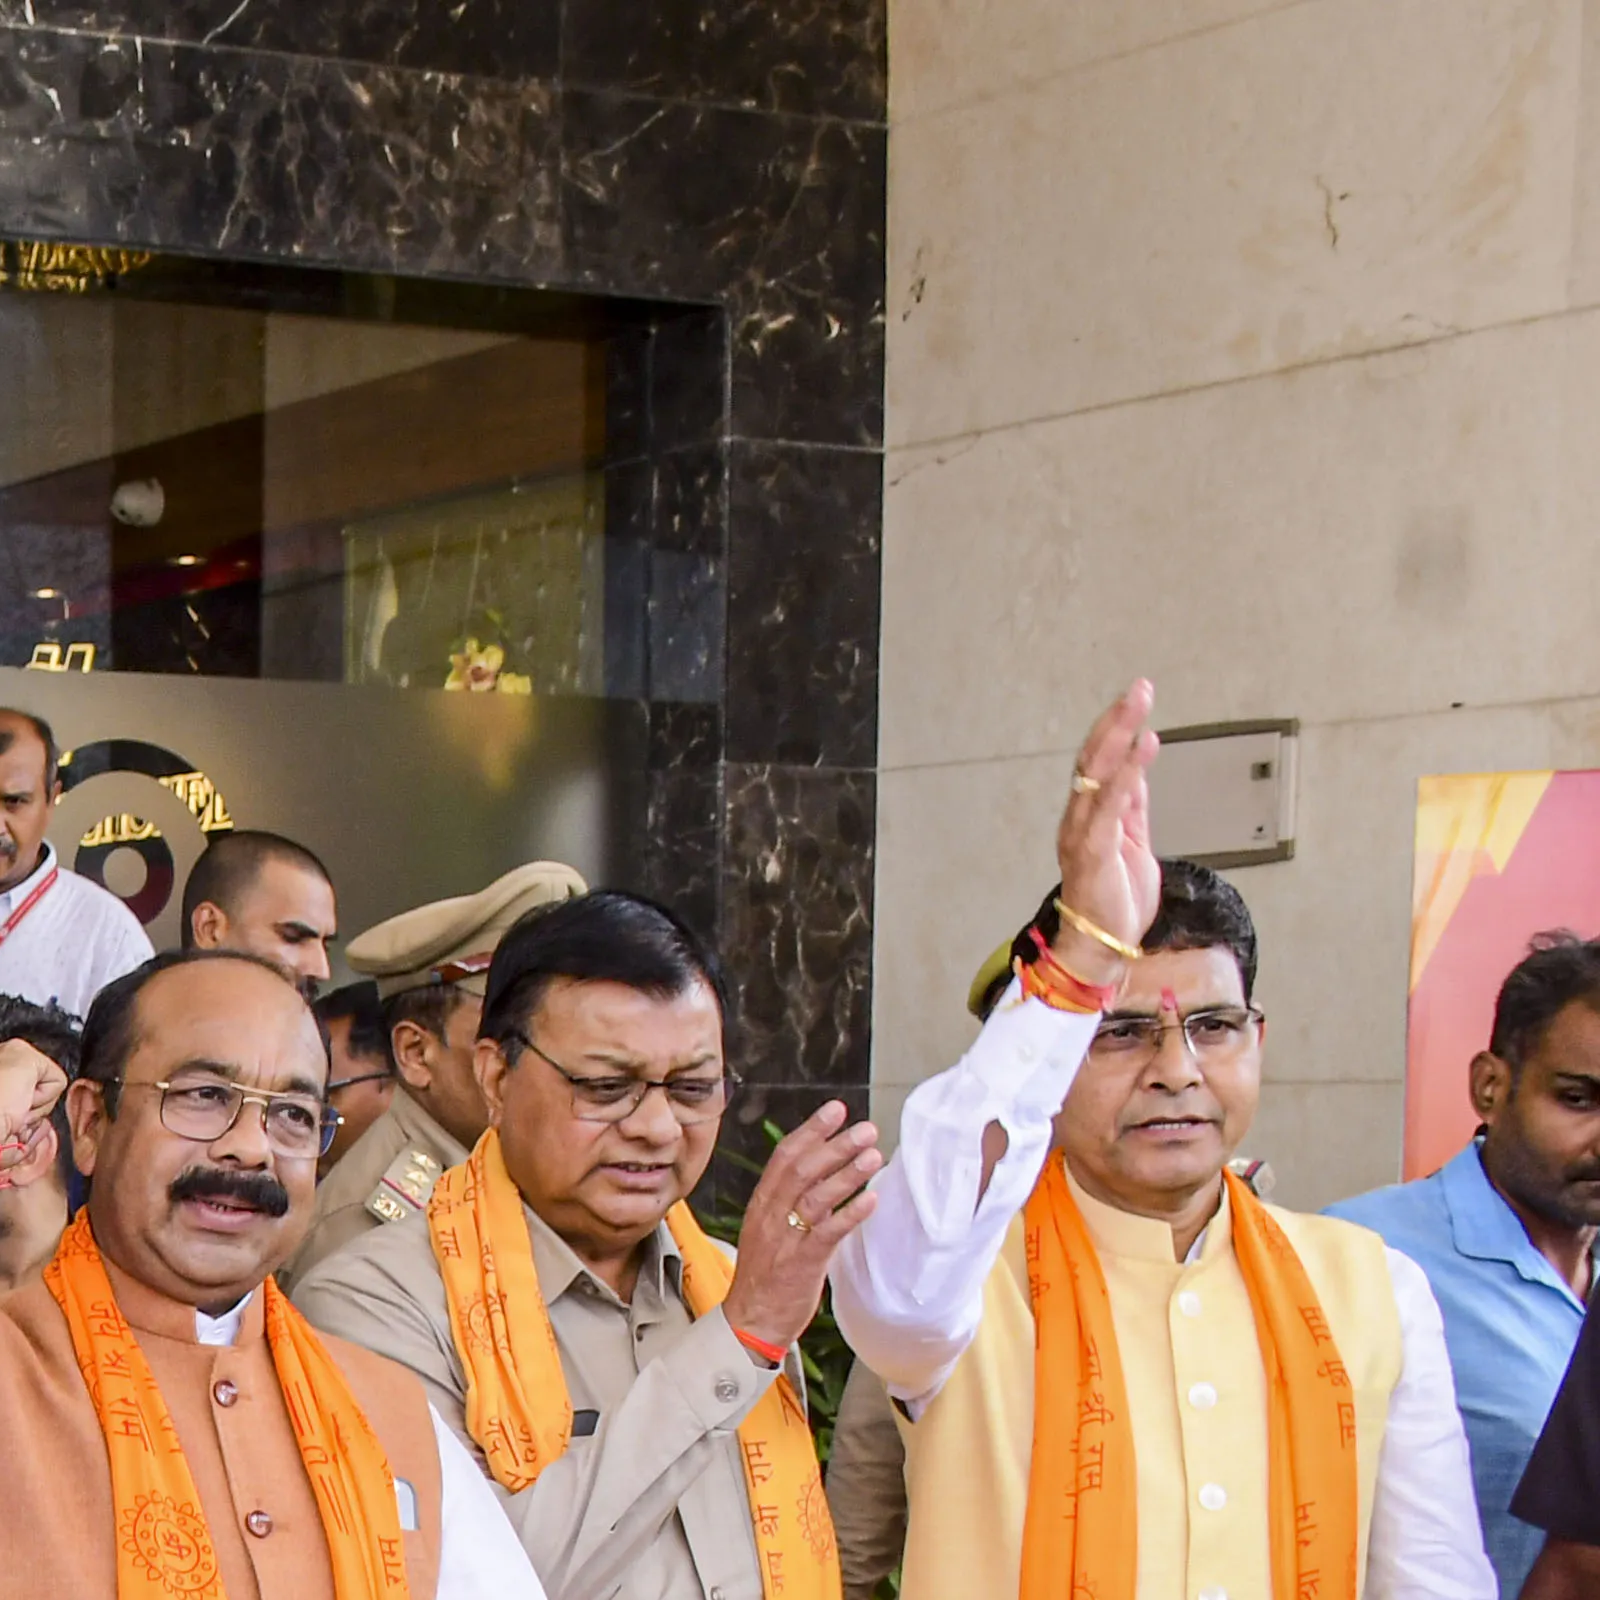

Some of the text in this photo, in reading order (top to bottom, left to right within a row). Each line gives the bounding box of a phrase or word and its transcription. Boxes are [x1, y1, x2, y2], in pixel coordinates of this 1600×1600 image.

[91, 1301, 127, 1341] जय
[108, 1397, 149, 1453] राम
[743, 1439, 775, 1488] राम
